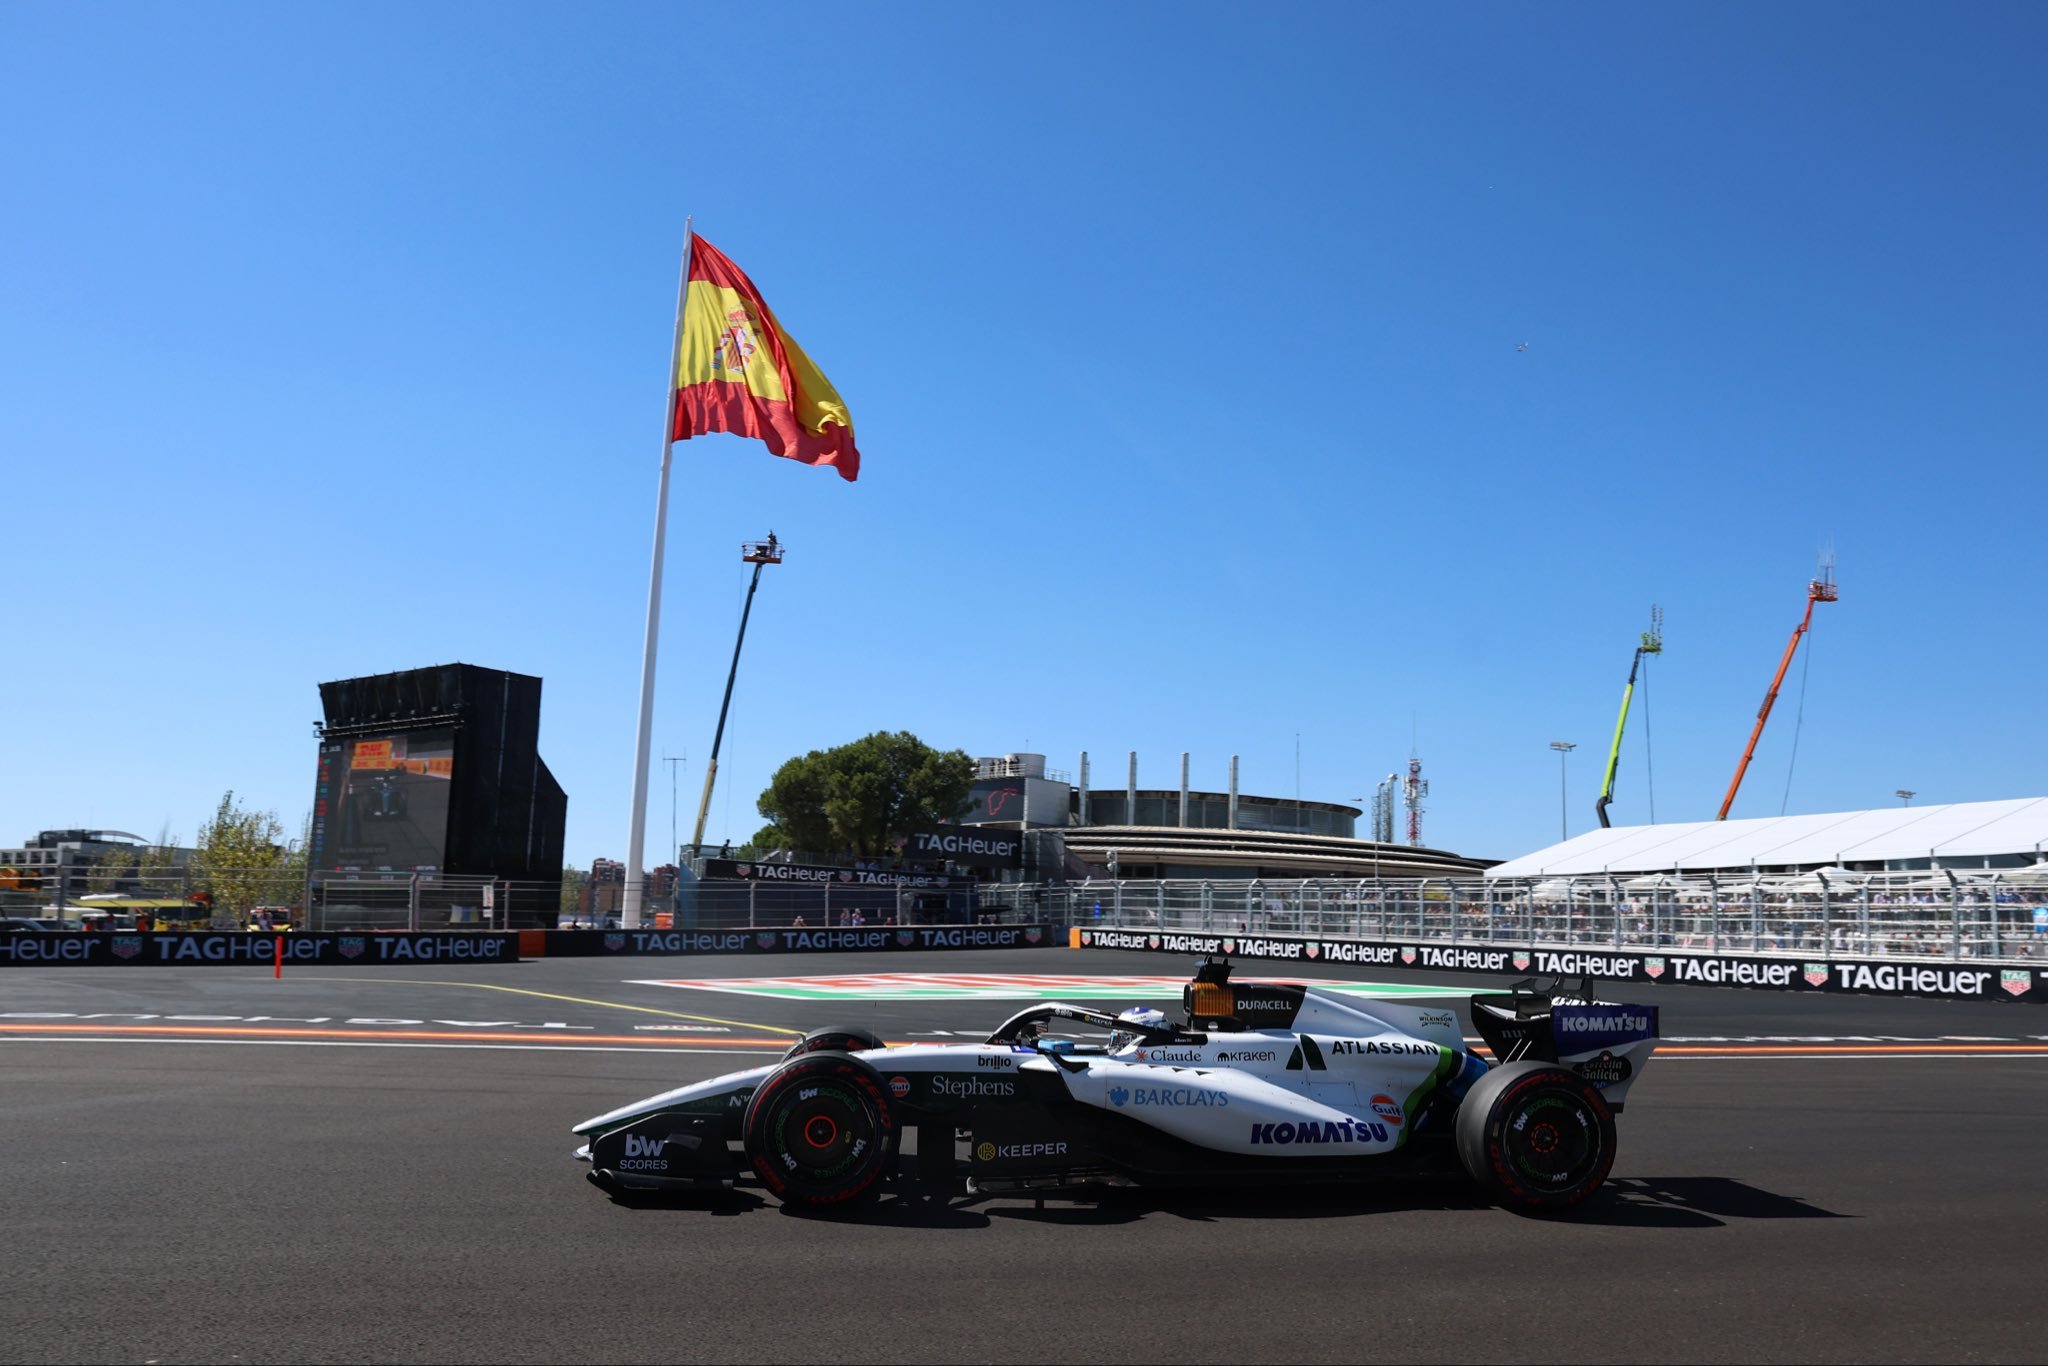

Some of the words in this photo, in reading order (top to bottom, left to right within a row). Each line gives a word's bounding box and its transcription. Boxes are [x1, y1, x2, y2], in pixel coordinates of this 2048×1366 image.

[755, 864, 835, 882] TAGHeuer
[632, 933, 751, 951] TAGHeuer
[782, 931, 891, 949] TAGHeuer
[920, 930, 1020, 947] TAGHeuer
[1093, 932, 1147, 949] TAGHeuer
[1162, 935, 1221, 953] TAGHeuer
[374, 936, 506, 960] TAGHeuer
[1237, 939, 1303, 958] TAGHeuer
[1322, 943, 1398, 964] TAGHeuer
[1420, 947, 1509, 970] TAGHeuer
[1534, 952, 1640, 977] TAGHeuer
[1670, 958, 1798, 985] TAGHeuer
[1835, 964, 1992, 994] TAGHeuer
[1237, 1000, 1292, 1010] DURACELL
[1562, 1013, 1648, 1032] KOMATSU
[1151, 1050, 1202, 1062] Claude
[1332, 1041, 1439, 1056] ATLASSIAN
[932, 1075, 1015, 1099] Stephens
[1134, 1088, 1229, 1106] BARCLAYS
[1372, 1103, 1402, 1117] Gulf
[1251, 1117, 1389, 1144] KOMATSU
[624, 1133, 666, 1157] bw
[998, 1142, 1068, 1158] KEEPER
[619, 1159, 669, 1171] SCORES
